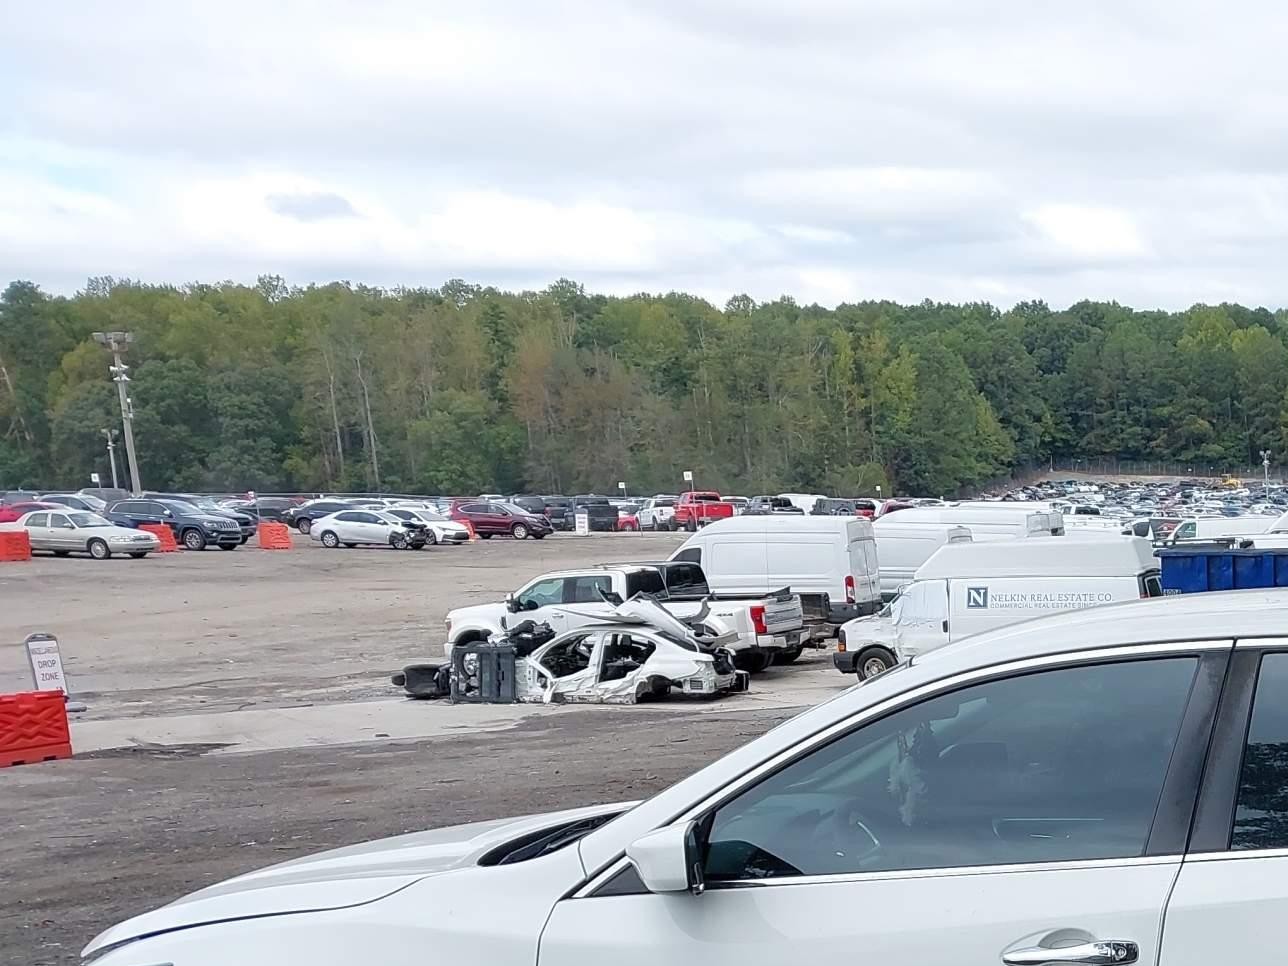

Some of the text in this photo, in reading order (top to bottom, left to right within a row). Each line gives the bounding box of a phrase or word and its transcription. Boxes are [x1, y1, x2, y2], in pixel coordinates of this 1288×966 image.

[968, 588, 986, 607] N
[990, 593, 1114, 602] NELKIN REAL ESTATE CO.
[37, 659, 57, 669] DROP
[40, 672, 60, 682] ZONE
